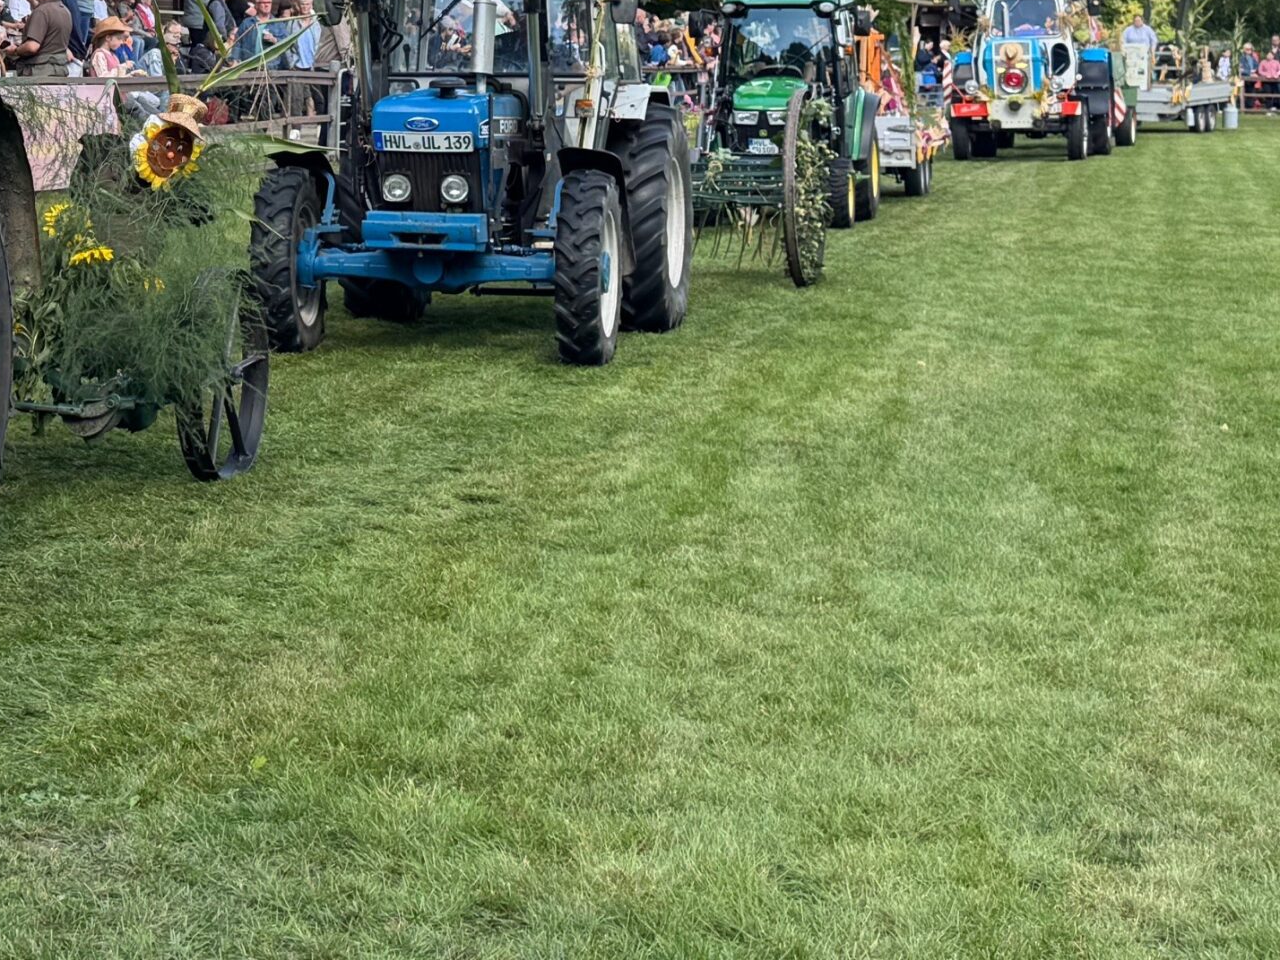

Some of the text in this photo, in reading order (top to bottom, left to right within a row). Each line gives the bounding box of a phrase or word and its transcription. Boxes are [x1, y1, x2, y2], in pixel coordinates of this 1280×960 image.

[500, 120, 518, 134] FORD
[384, 135, 471, 150] HVL UL 139
